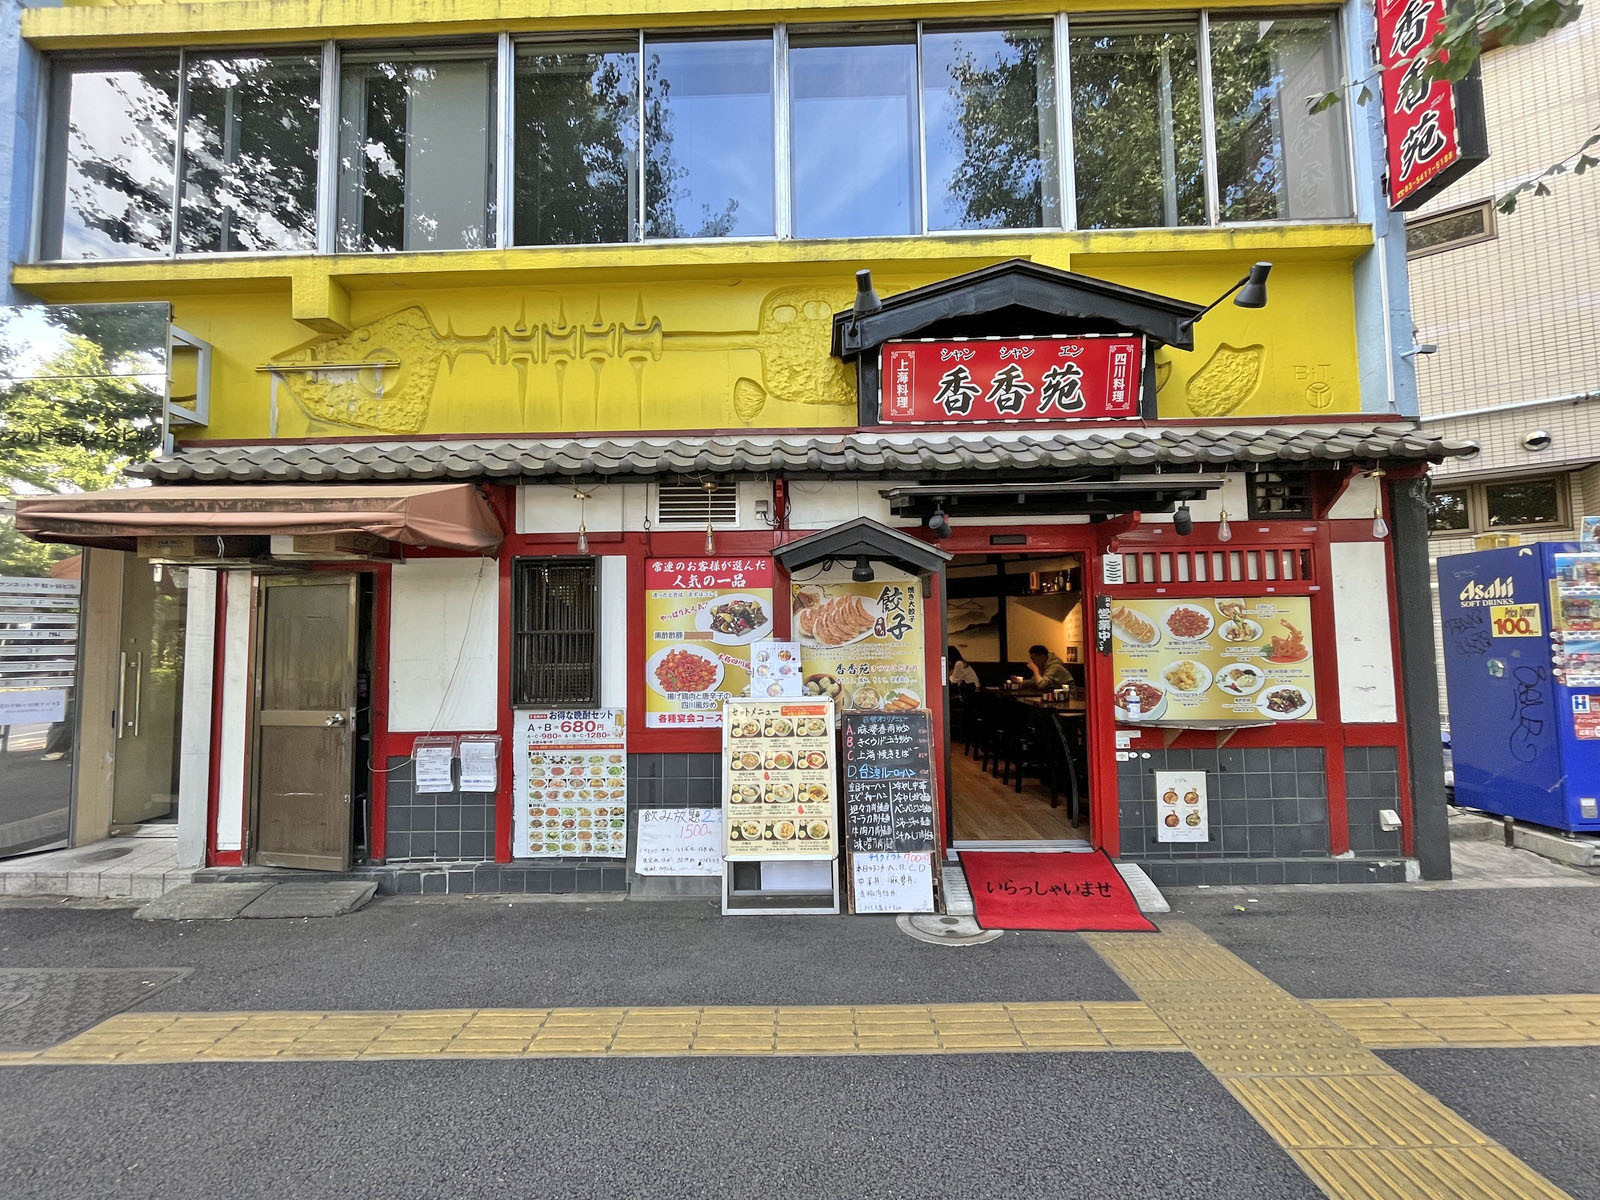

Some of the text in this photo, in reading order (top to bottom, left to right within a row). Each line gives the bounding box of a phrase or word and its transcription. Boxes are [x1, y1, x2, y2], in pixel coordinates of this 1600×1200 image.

[940, 344, 1084, 361] シャン シャン エン
[896, 358, 909, 408] 上海料理
[1112, 353, 1127, 403] 四川料理
[933, 362, 1086, 415] 香香苑
[652, 560, 767, 573] 常連のお客様が選んだ
[672, 573, 747, 588] 人気の一品
[1460, 576, 1514, 601] Asahi
[1461, 598, 1514, 608] SOFT DRINKS
[876, 586, 913, 640] 餃子
[835, 662, 870, 675] 香香苑
[681, 701, 717, 709] 四川風炒め
[732, 708, 779, 717] セットメニュー
[549, 710, 613, 720] お得な晩酌セット
[658, 713, 723, 724] 各種宴会コース
[643, 808, 700, 823] 飲み放題
[986, 879, 1113, 898] いらっしゃいませ
